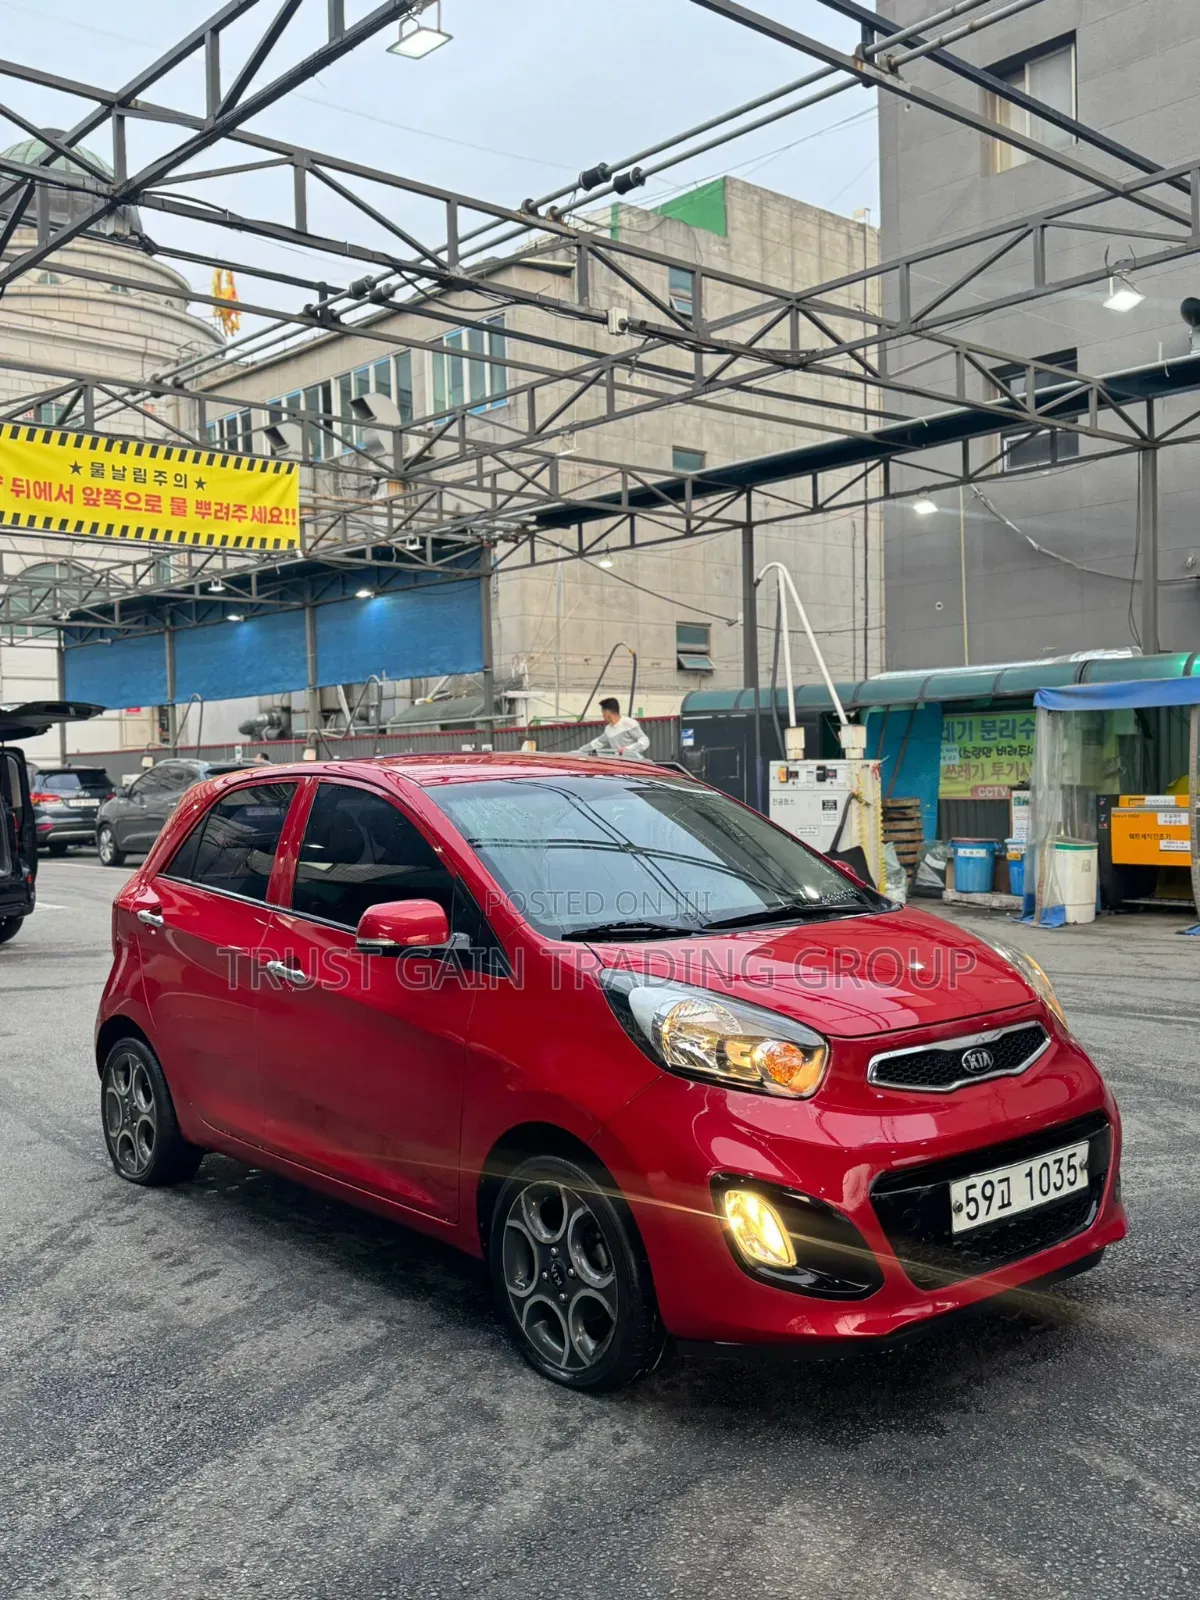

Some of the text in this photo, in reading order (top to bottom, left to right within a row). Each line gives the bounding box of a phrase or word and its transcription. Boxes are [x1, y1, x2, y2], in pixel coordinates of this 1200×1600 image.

[10, 477, 297, 527] 뒤에서 앞쪽으로 물 뿌려주세요!!
[978, 786, 1008, 797] CCTV
[967, 1052, 991, 1070] KIA
[965, 1152, 1078, 1221] 59고 1035
